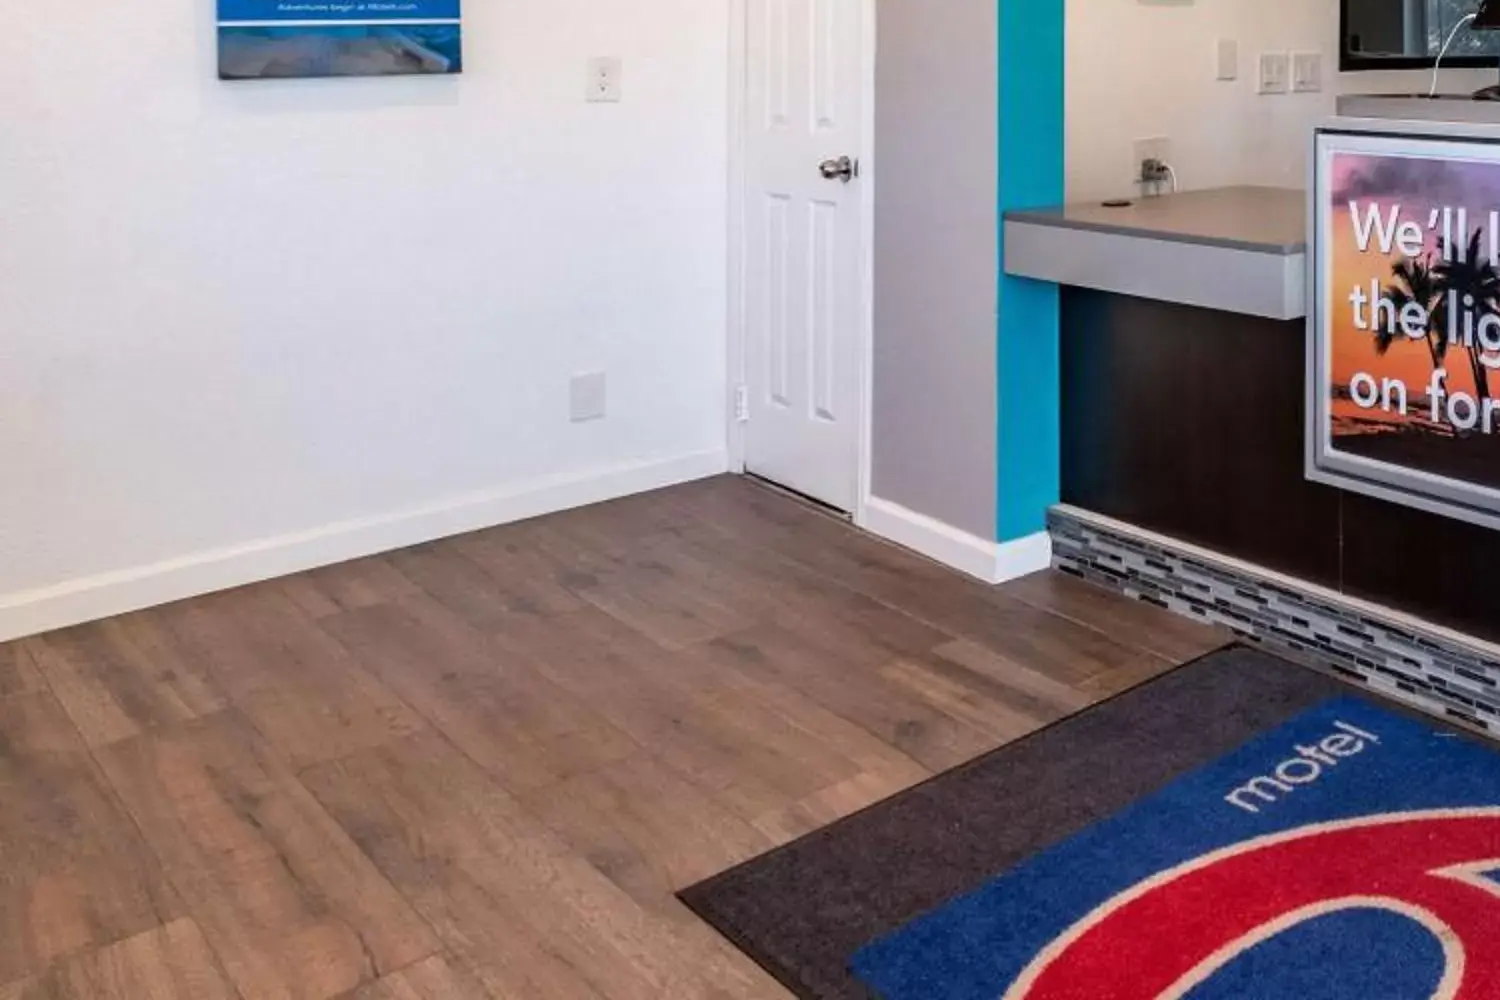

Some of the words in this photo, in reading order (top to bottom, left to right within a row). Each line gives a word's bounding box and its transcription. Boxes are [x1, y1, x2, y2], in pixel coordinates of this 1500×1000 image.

[1349, 200, 1467, 265] We'll
[1349, 278, 1428, 339] the
[1350, 371, 1407, 416] on
[1224, 719, 1382, 813] motel
